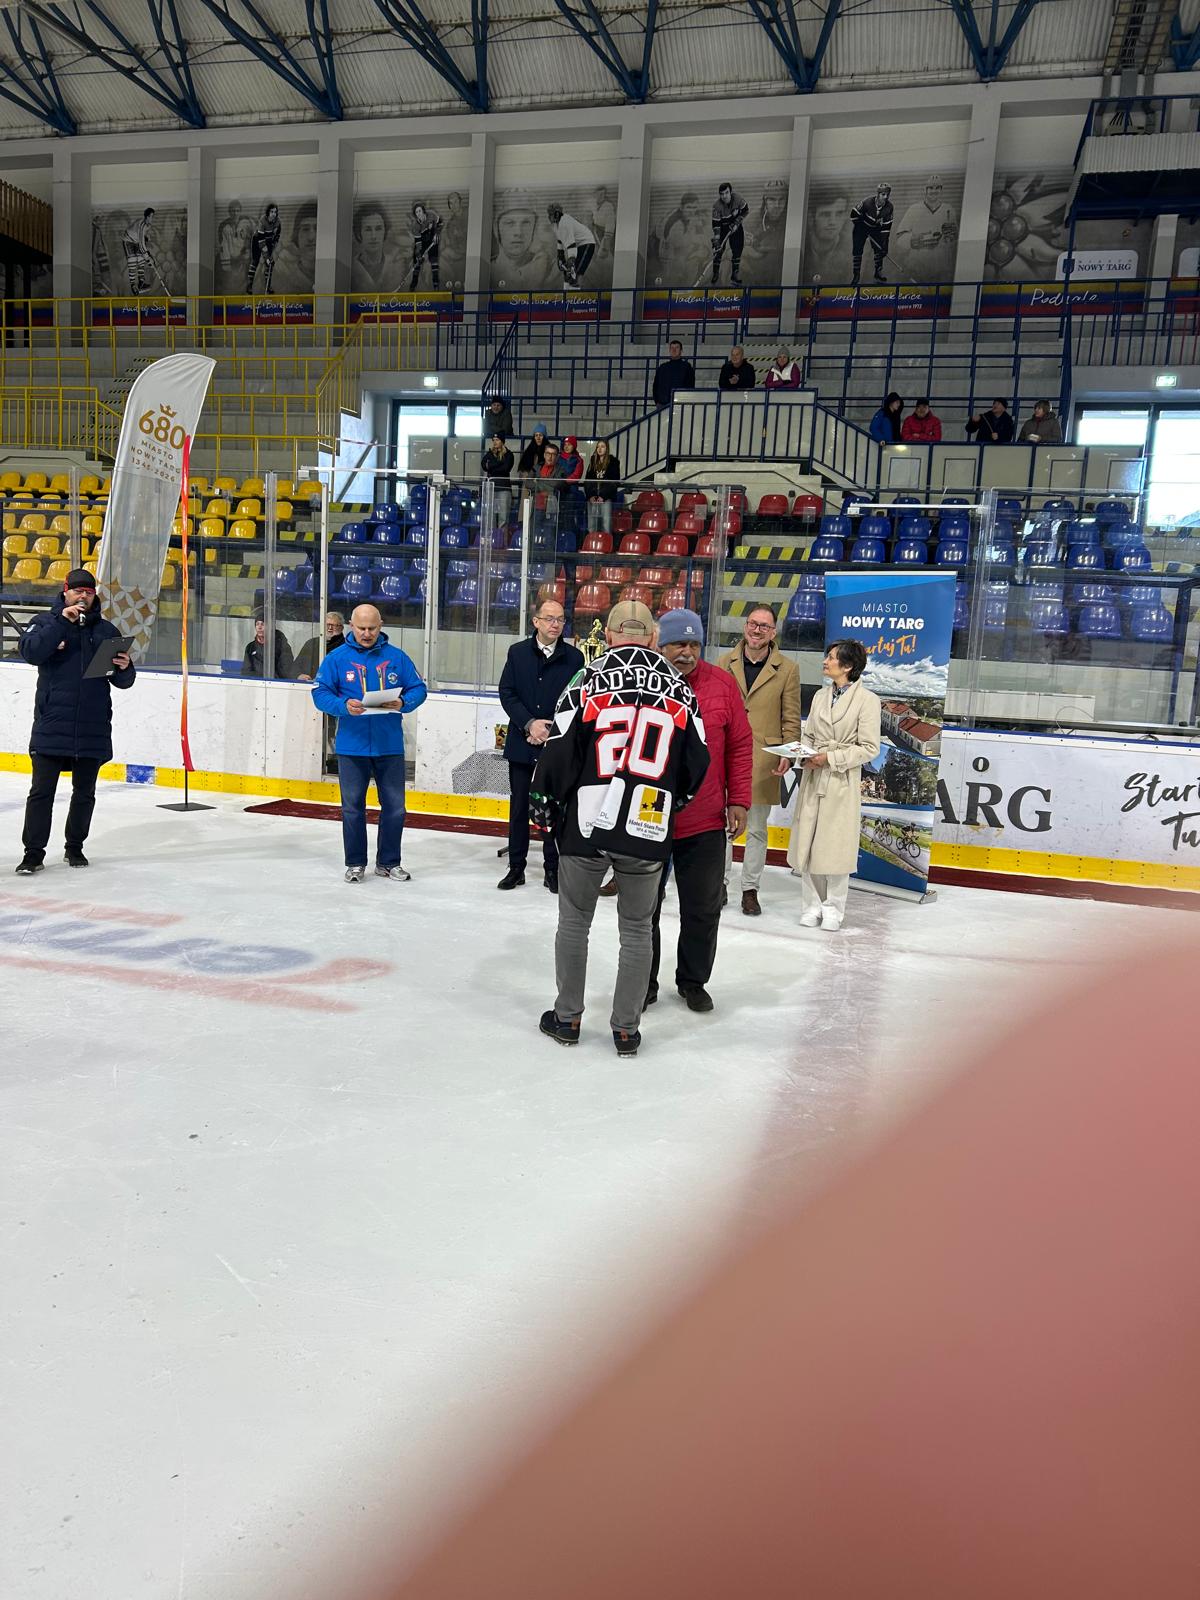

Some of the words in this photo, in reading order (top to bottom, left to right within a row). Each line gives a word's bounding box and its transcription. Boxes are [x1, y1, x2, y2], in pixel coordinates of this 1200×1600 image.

[1107, 263, 1133, 271] TARG
[139, 409, 185, 449] 680
[130, 445, 156, 462] NOWY
[158, 458, 181, 474] TARG
[141, 440, 173, 460] MIASTO
[862, 603, 908, 614] MIASTO
[842, 615, 885, 629] NOWY
[888, 617, 925, 630] TARG
[895, 634, 917, 657] Tu!
[595, 703, 675, 781] 20
[936, 778, 1053, 833] ARG
